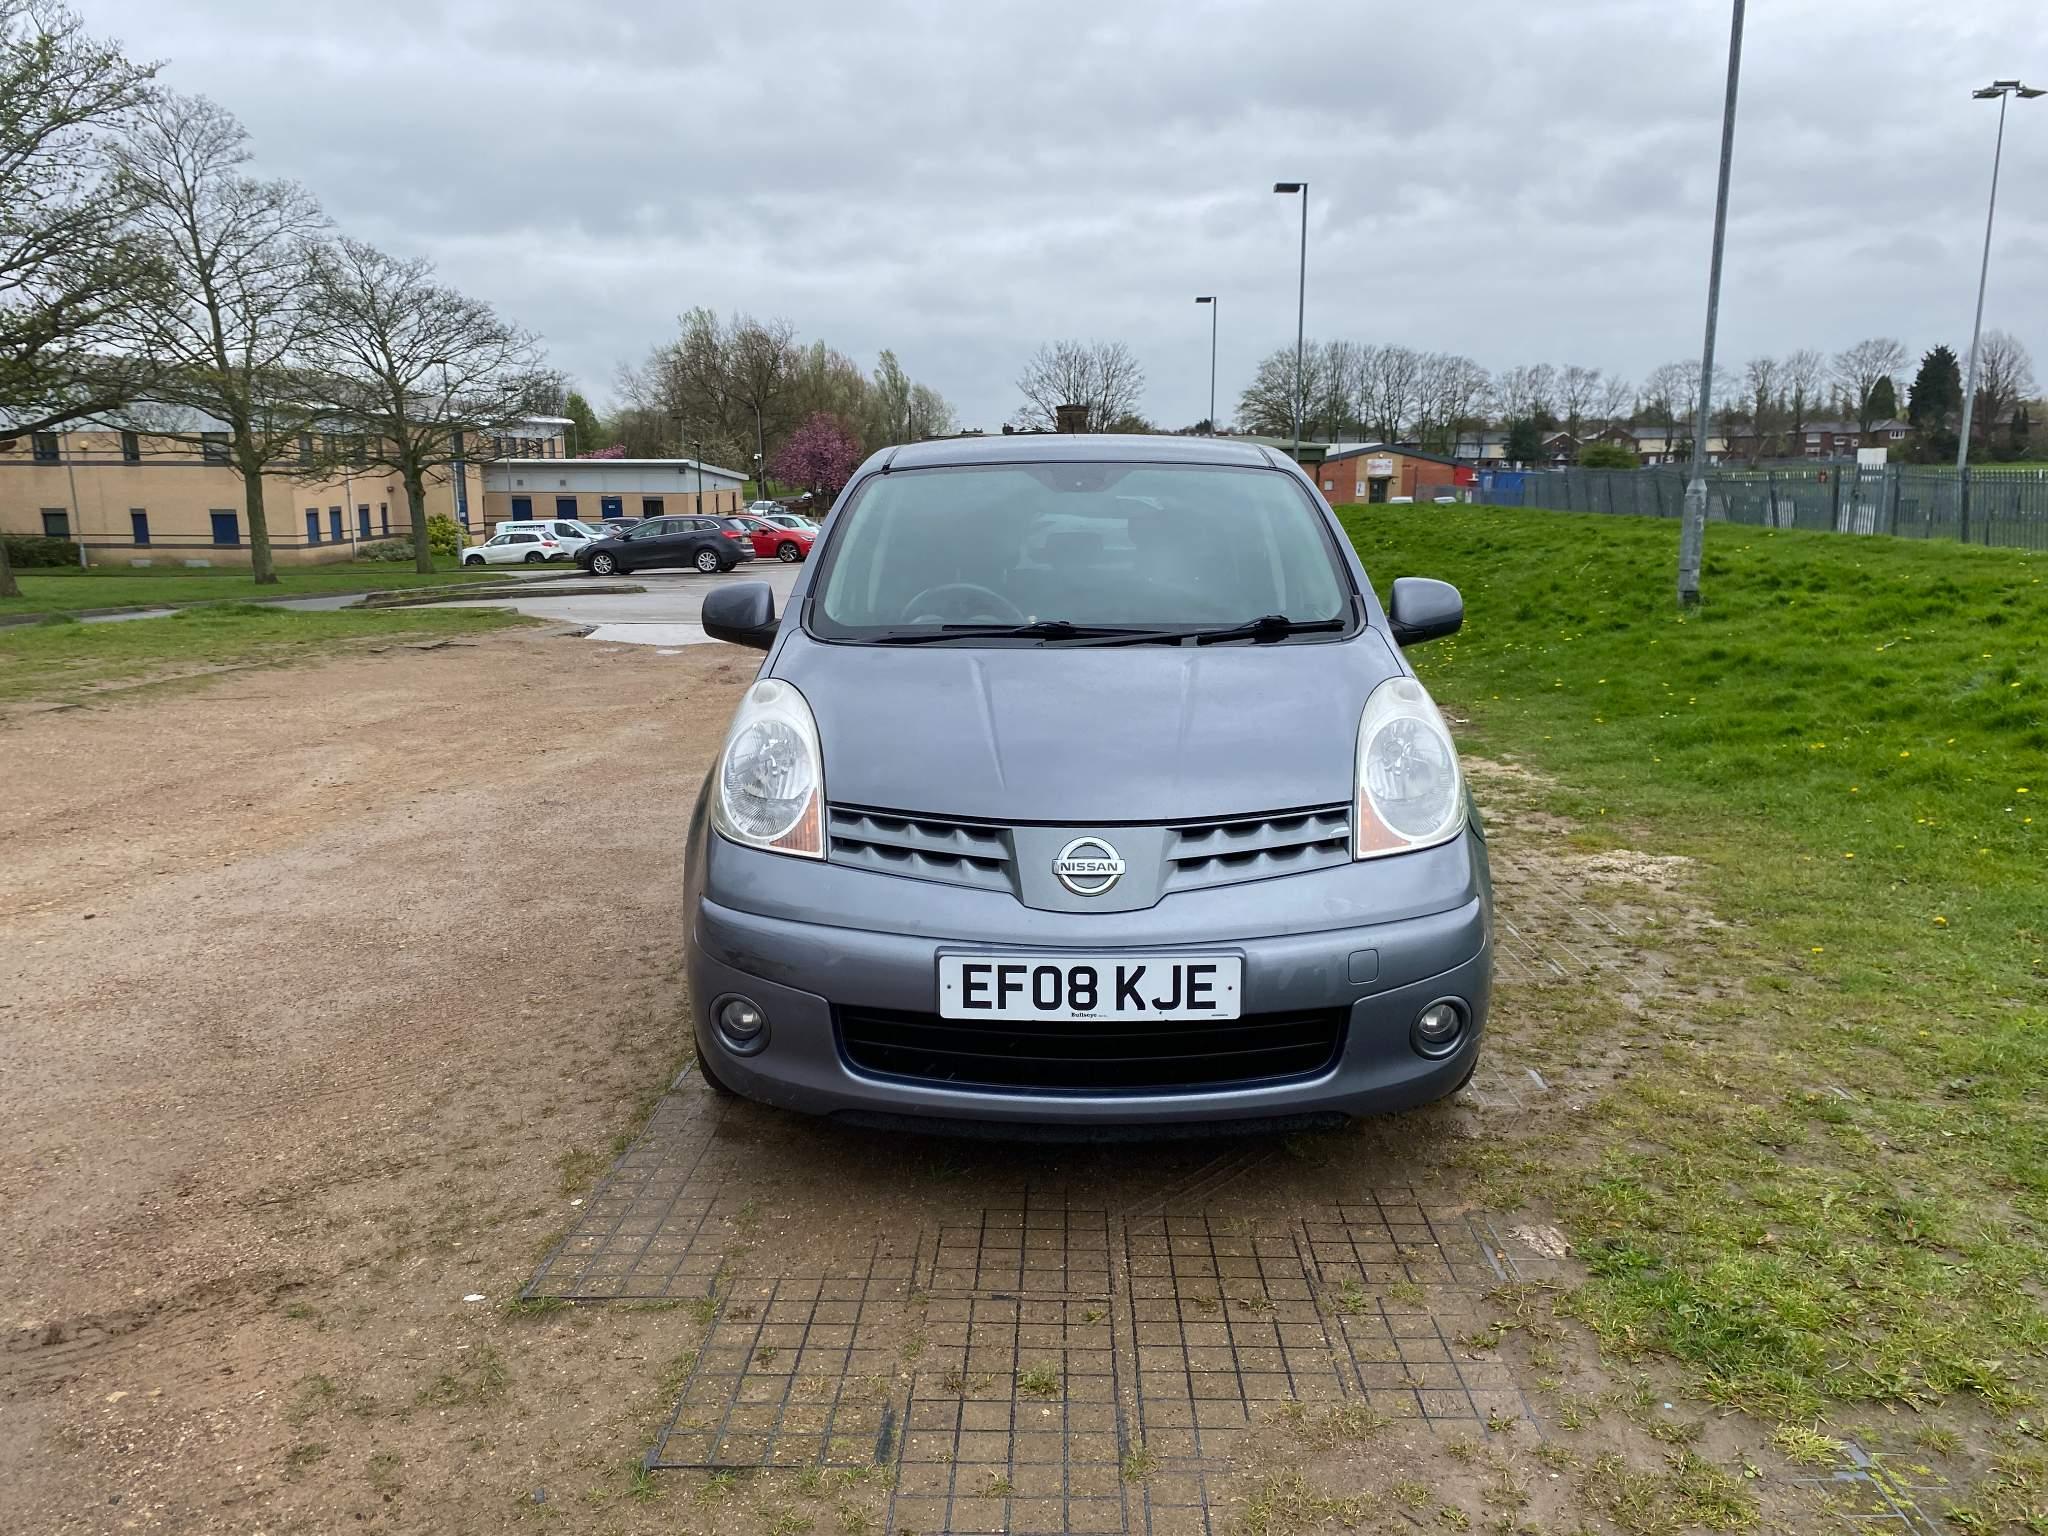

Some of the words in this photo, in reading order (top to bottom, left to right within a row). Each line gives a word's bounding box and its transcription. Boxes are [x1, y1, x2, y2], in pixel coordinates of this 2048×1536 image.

[1060, 862, 1118, 872] NISSAN
[962, 964, 1098, 1010] EF08
[1115, 964, 1217, 1010] KJE
